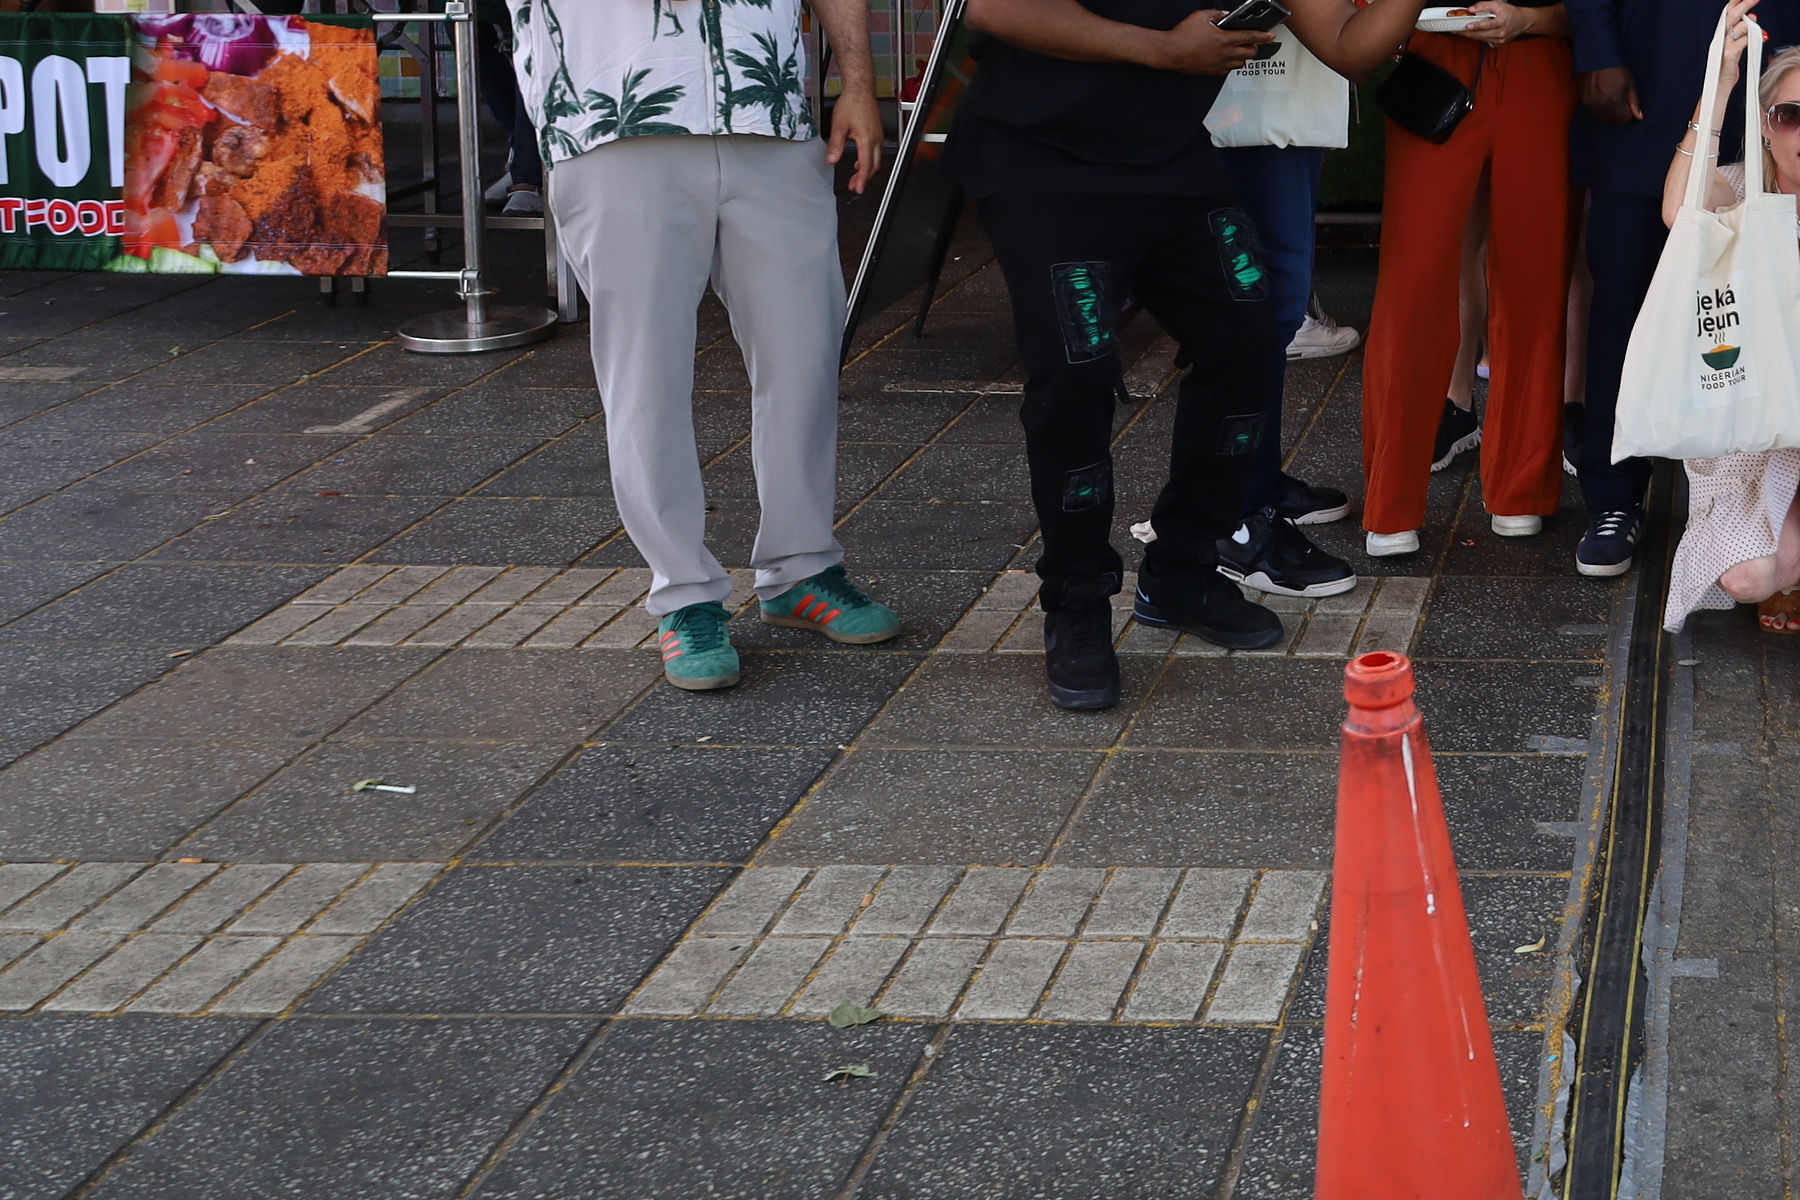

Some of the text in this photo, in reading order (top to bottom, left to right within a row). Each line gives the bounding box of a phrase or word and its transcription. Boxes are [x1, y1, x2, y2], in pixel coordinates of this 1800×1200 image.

[1245, 61, 1286, 69] IGERIAN
[1701, 366, 1745, 382] NIGERIAN
[1701, 375, 1745, 390] FOOD TOUR
